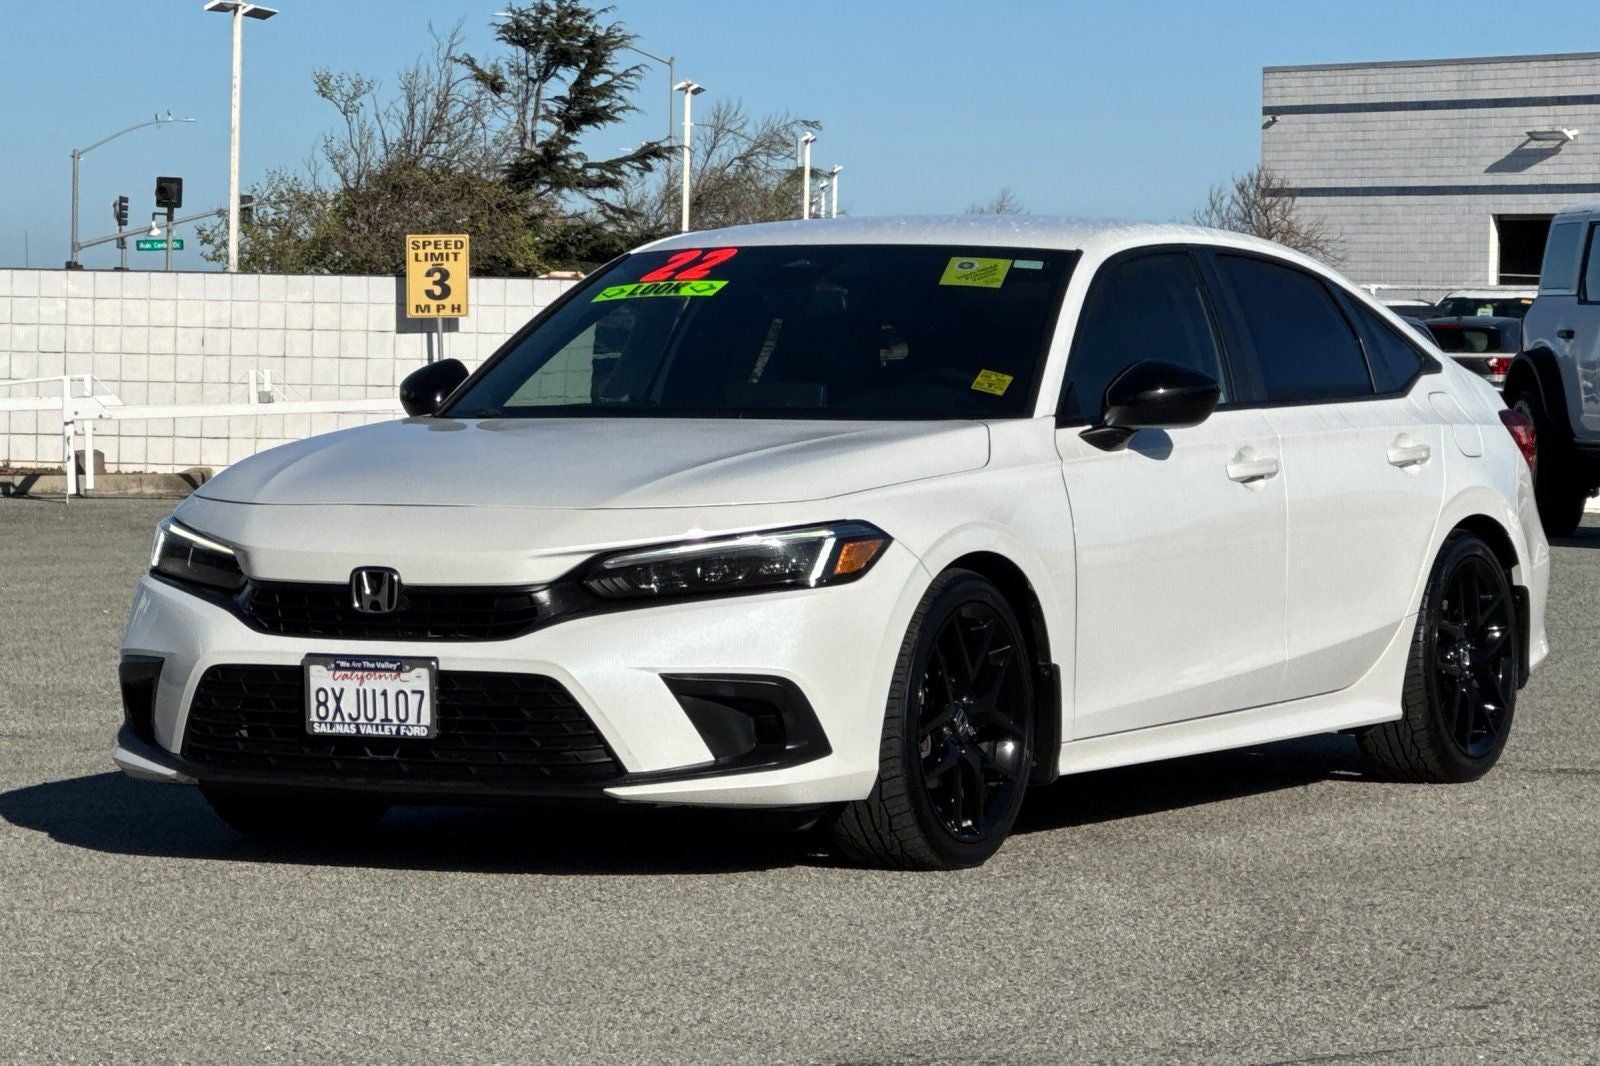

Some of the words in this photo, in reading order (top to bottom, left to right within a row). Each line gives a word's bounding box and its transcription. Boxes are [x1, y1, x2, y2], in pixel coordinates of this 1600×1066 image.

[411, 240, 464, 250] SPEED
[414, 252, 461, 262] LIMIT
[639, 248, 738, 282] 22
[424, 267, 451, 301] 3
[627, 282, 689, 297] LOOK
[332, 671, 410, 687] California
[315, 687, 425, 724] 8XJU107
[313, 723, 357, 734] SALINAS
[359, 724, 398, 735] VALLEY
[400, 725, 428, 737] FORD
